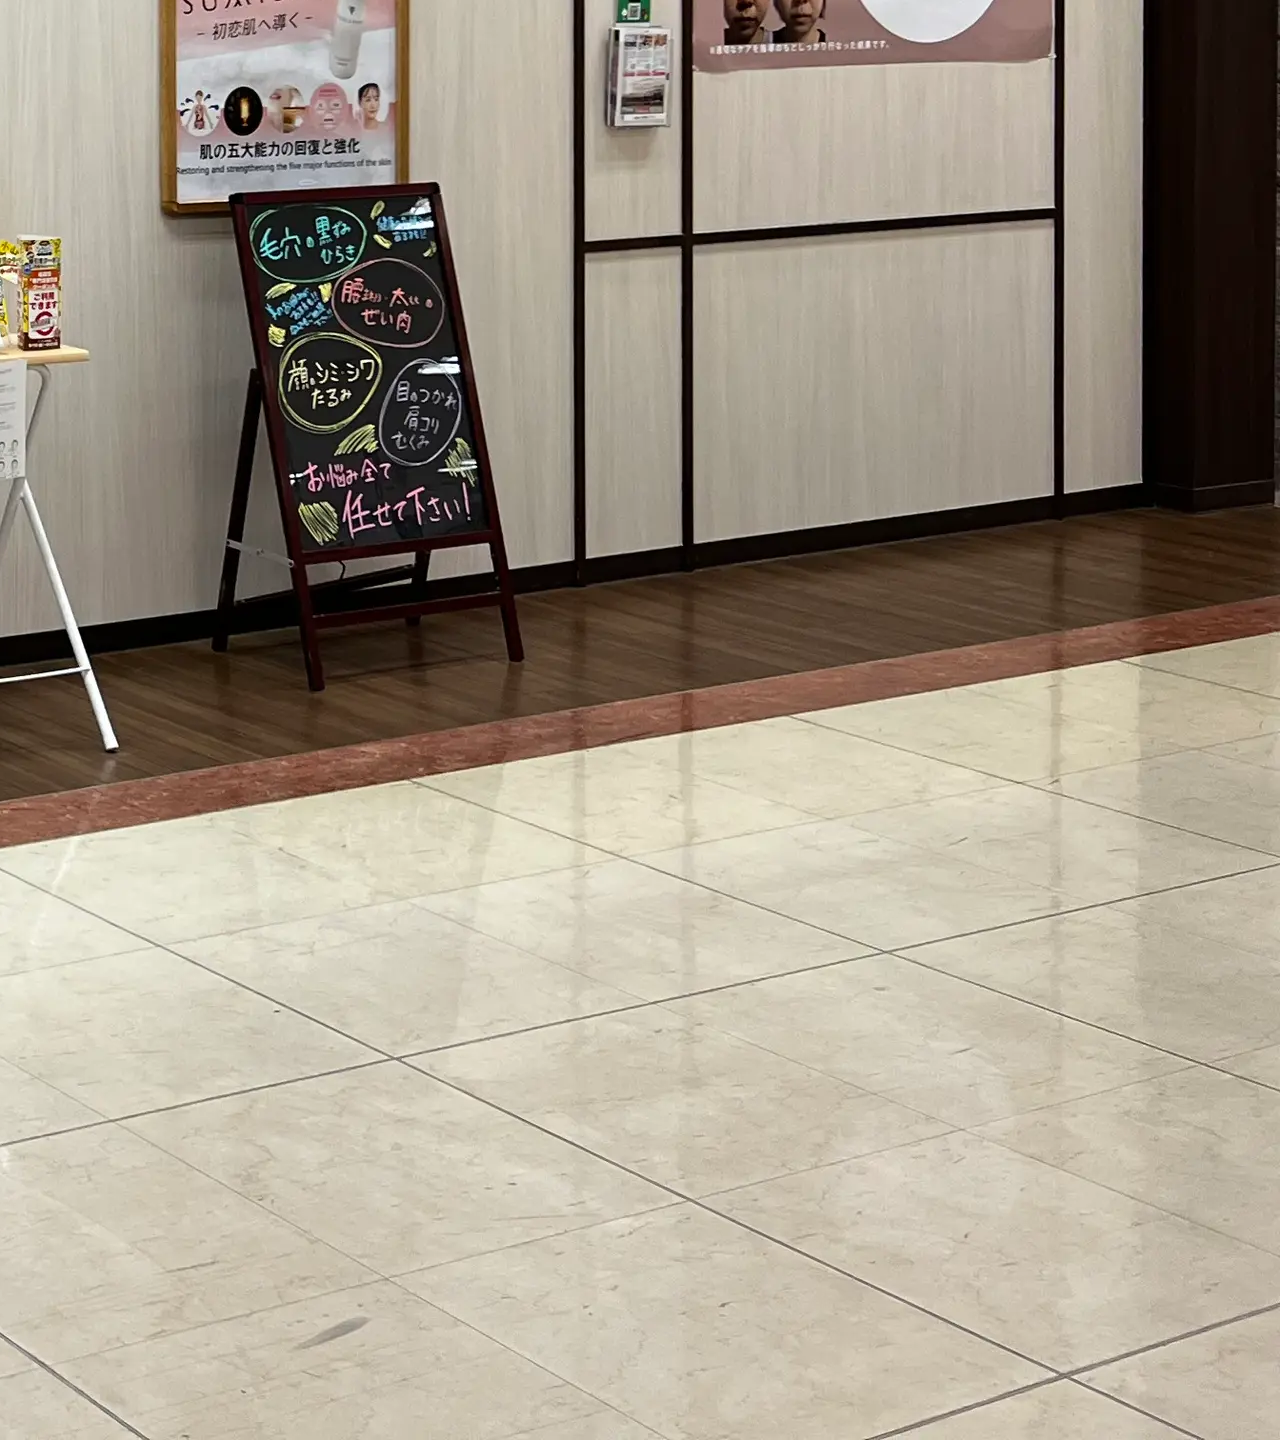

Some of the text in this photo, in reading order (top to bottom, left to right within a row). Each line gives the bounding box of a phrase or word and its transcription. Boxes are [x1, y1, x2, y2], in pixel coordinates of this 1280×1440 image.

[199, 138, 360, 160] 肌の五大能力の回復と強化
[211, 164, 225, 173] and
[276, 163, 288, 171] the
[321, 244, 356, 265] ひらき
[361, 308, 412, 334] ぜい肉
[311, 388, 352, 410] たるみ
[404, 406, 440, 434] 肩コリ
[391, 431, 430, 450] むくみ
[303, 459, 391, 492] お悩み全て
